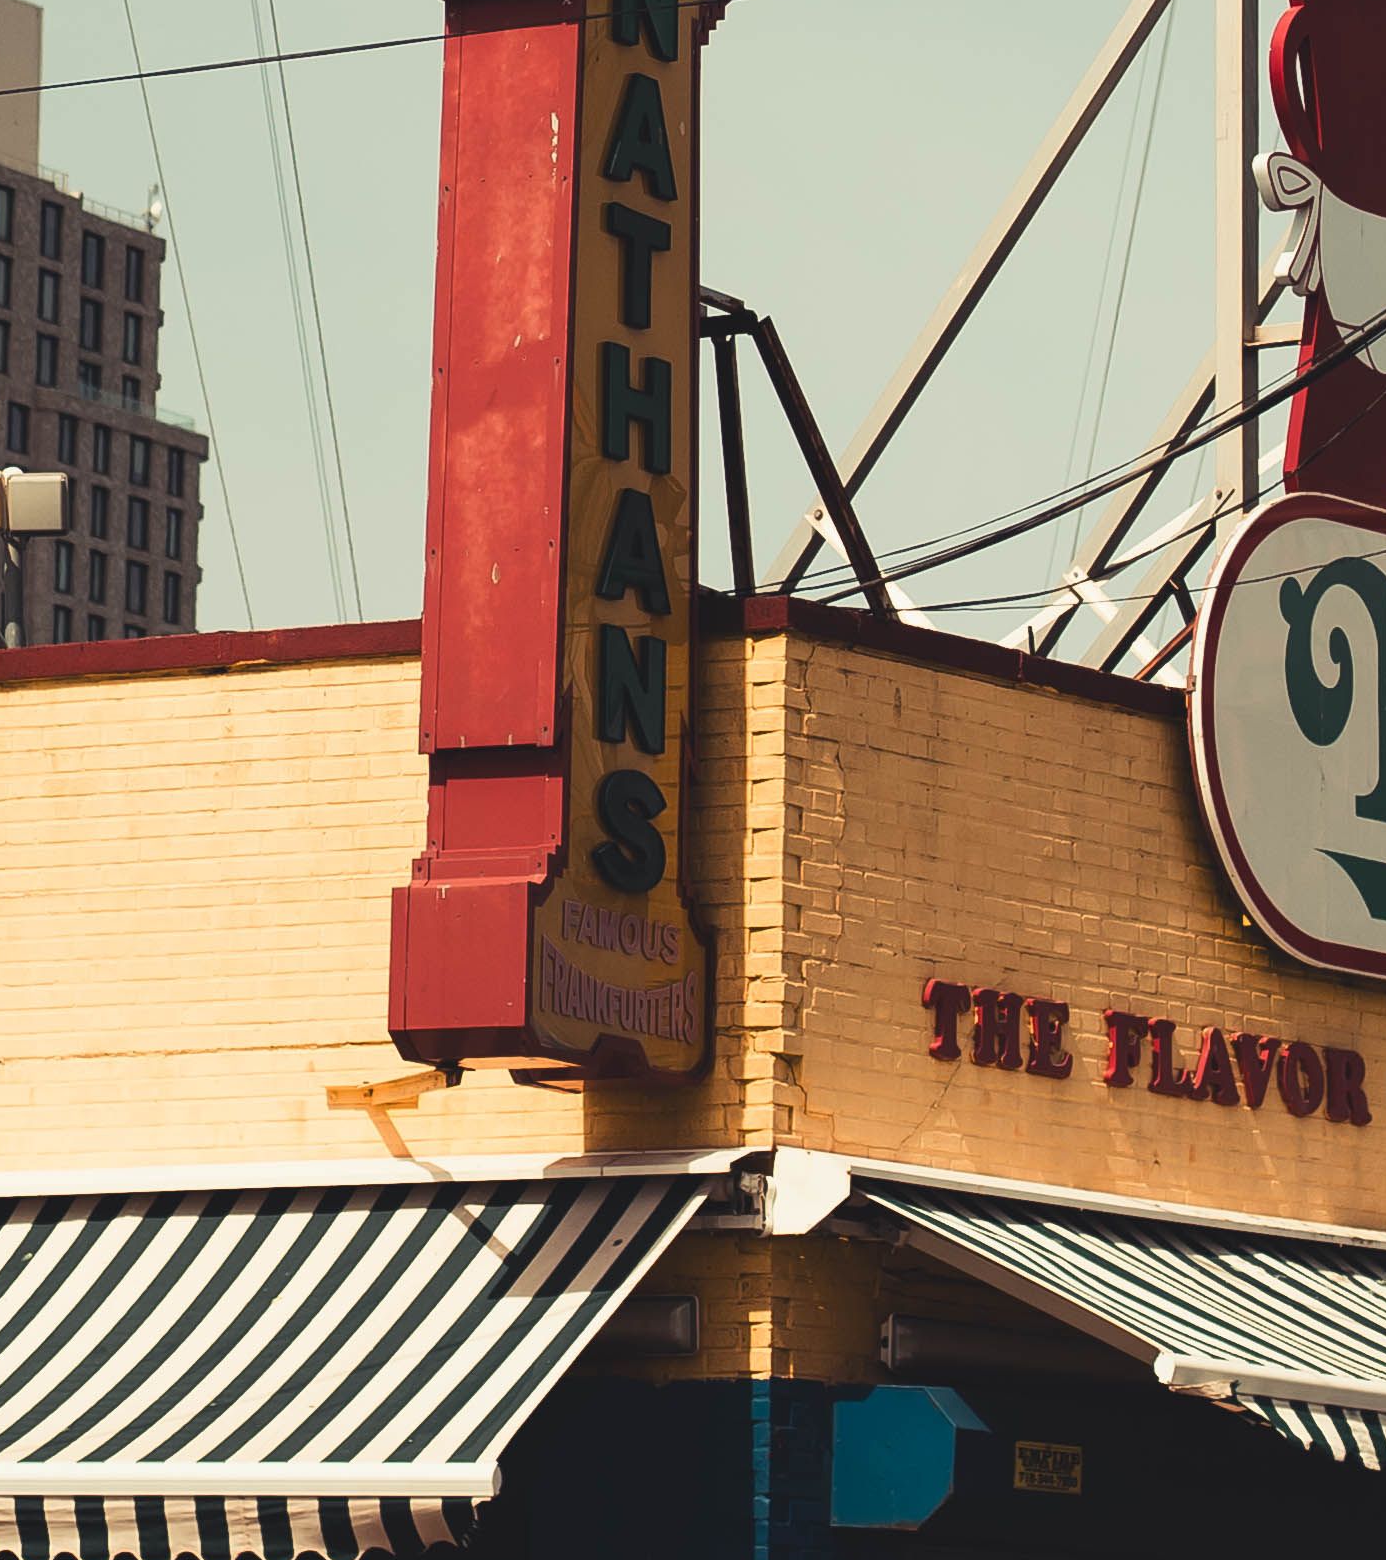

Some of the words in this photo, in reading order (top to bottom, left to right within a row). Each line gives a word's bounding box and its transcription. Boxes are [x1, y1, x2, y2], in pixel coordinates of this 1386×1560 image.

[538, 932, 702, 1046] FRANKFURTERS
[561, 898, 680, 966] FAMOUS
[921, 977, 1075, 1080] THE
[1102, 1008, 1374, 1128] FLAVOR
